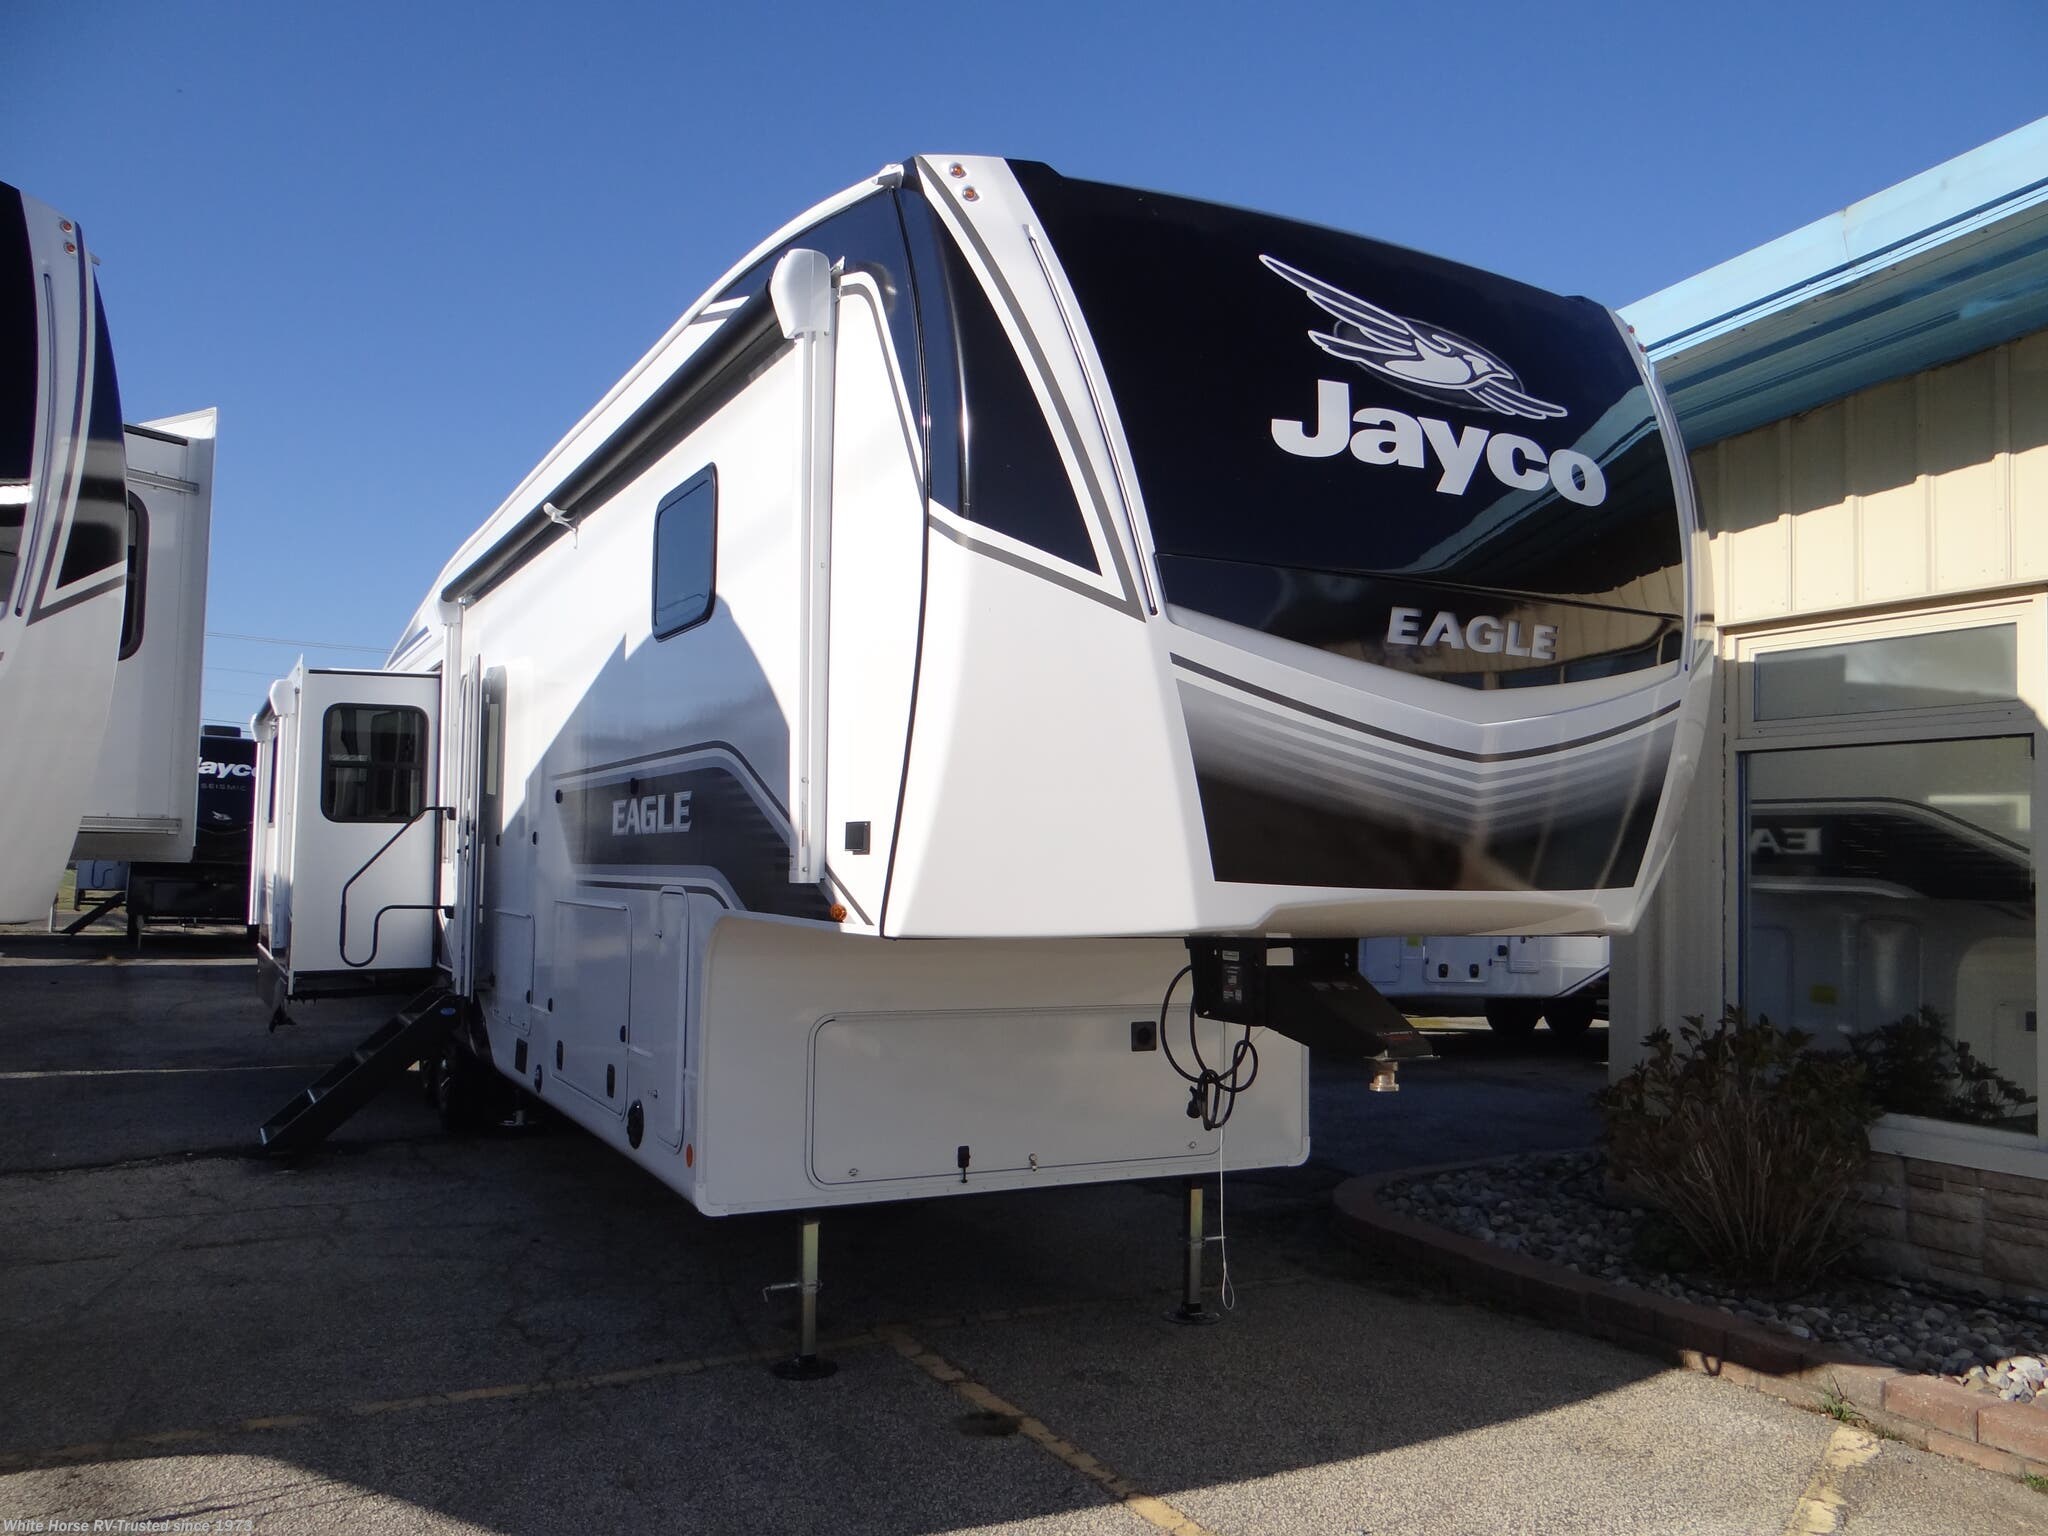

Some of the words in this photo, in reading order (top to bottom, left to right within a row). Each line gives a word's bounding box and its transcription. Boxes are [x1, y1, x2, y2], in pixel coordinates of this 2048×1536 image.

[1271, 379, 1606, 506] Jayco
[1388, 607, 1558, 660] EAGLE
[198, 757, 256, 778] ayc
[612, 790, 693, 836] EAGLE
